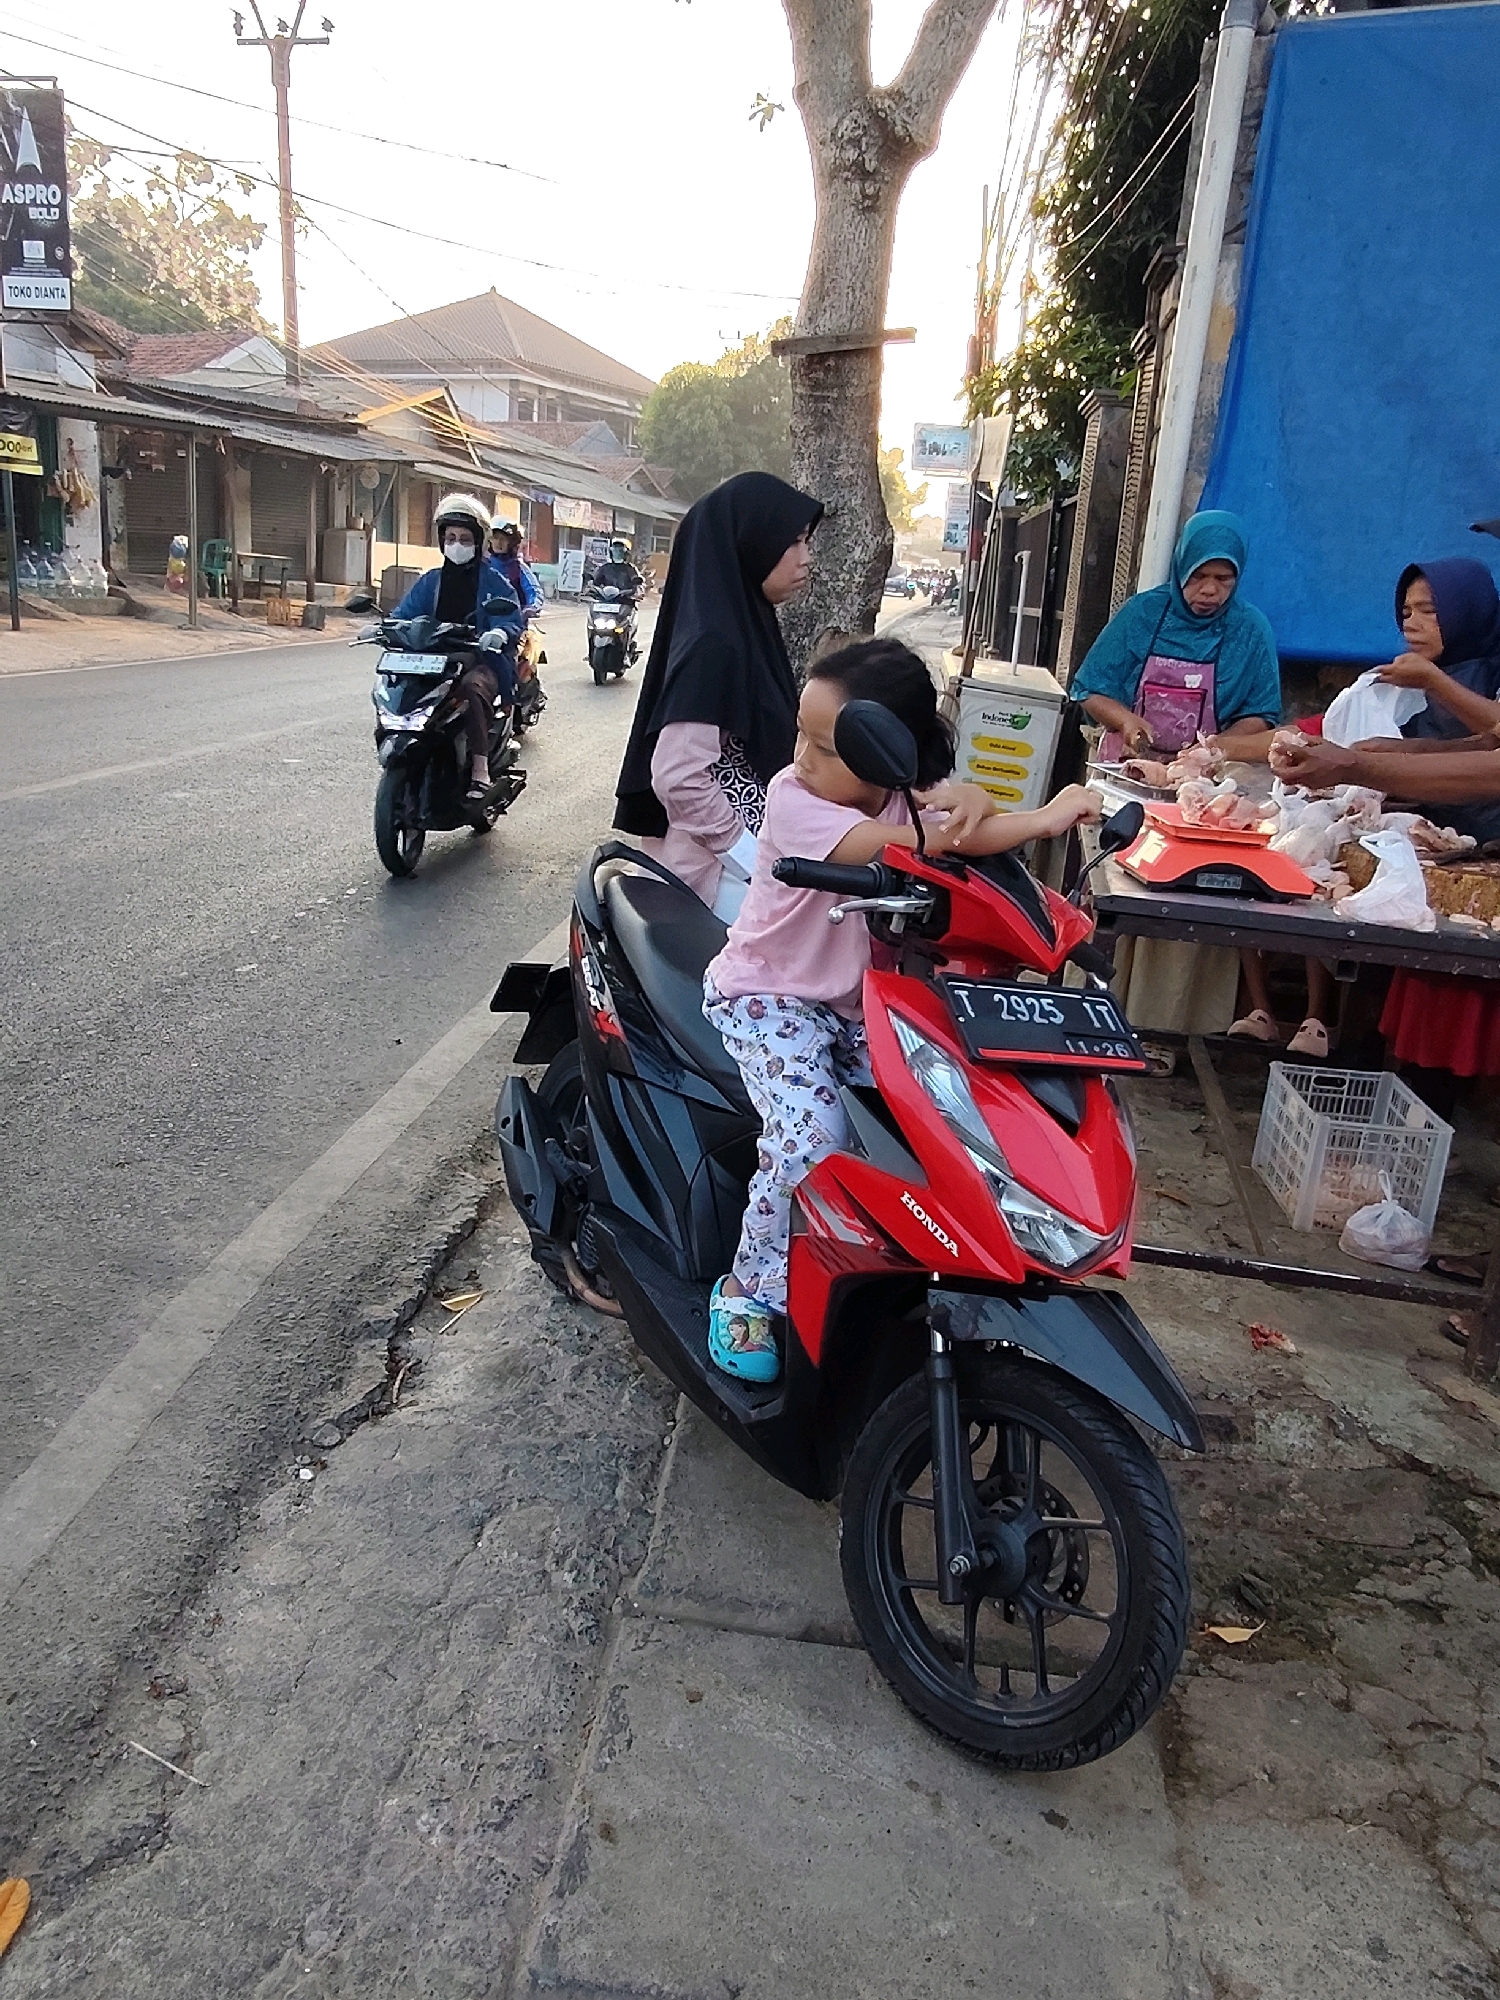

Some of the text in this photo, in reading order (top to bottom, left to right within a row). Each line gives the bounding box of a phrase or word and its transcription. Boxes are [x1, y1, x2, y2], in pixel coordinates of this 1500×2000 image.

[2, 183, 62, 205] ASPRO
[28, 207, 60, 220] BOLD
[7, 285, 67, 300] TOKO DIANTA
[954, 989, 976, 1019] T
[993, 993, 1065, 1025] 2925
[899, 1190, 960, 1258] HONDA
